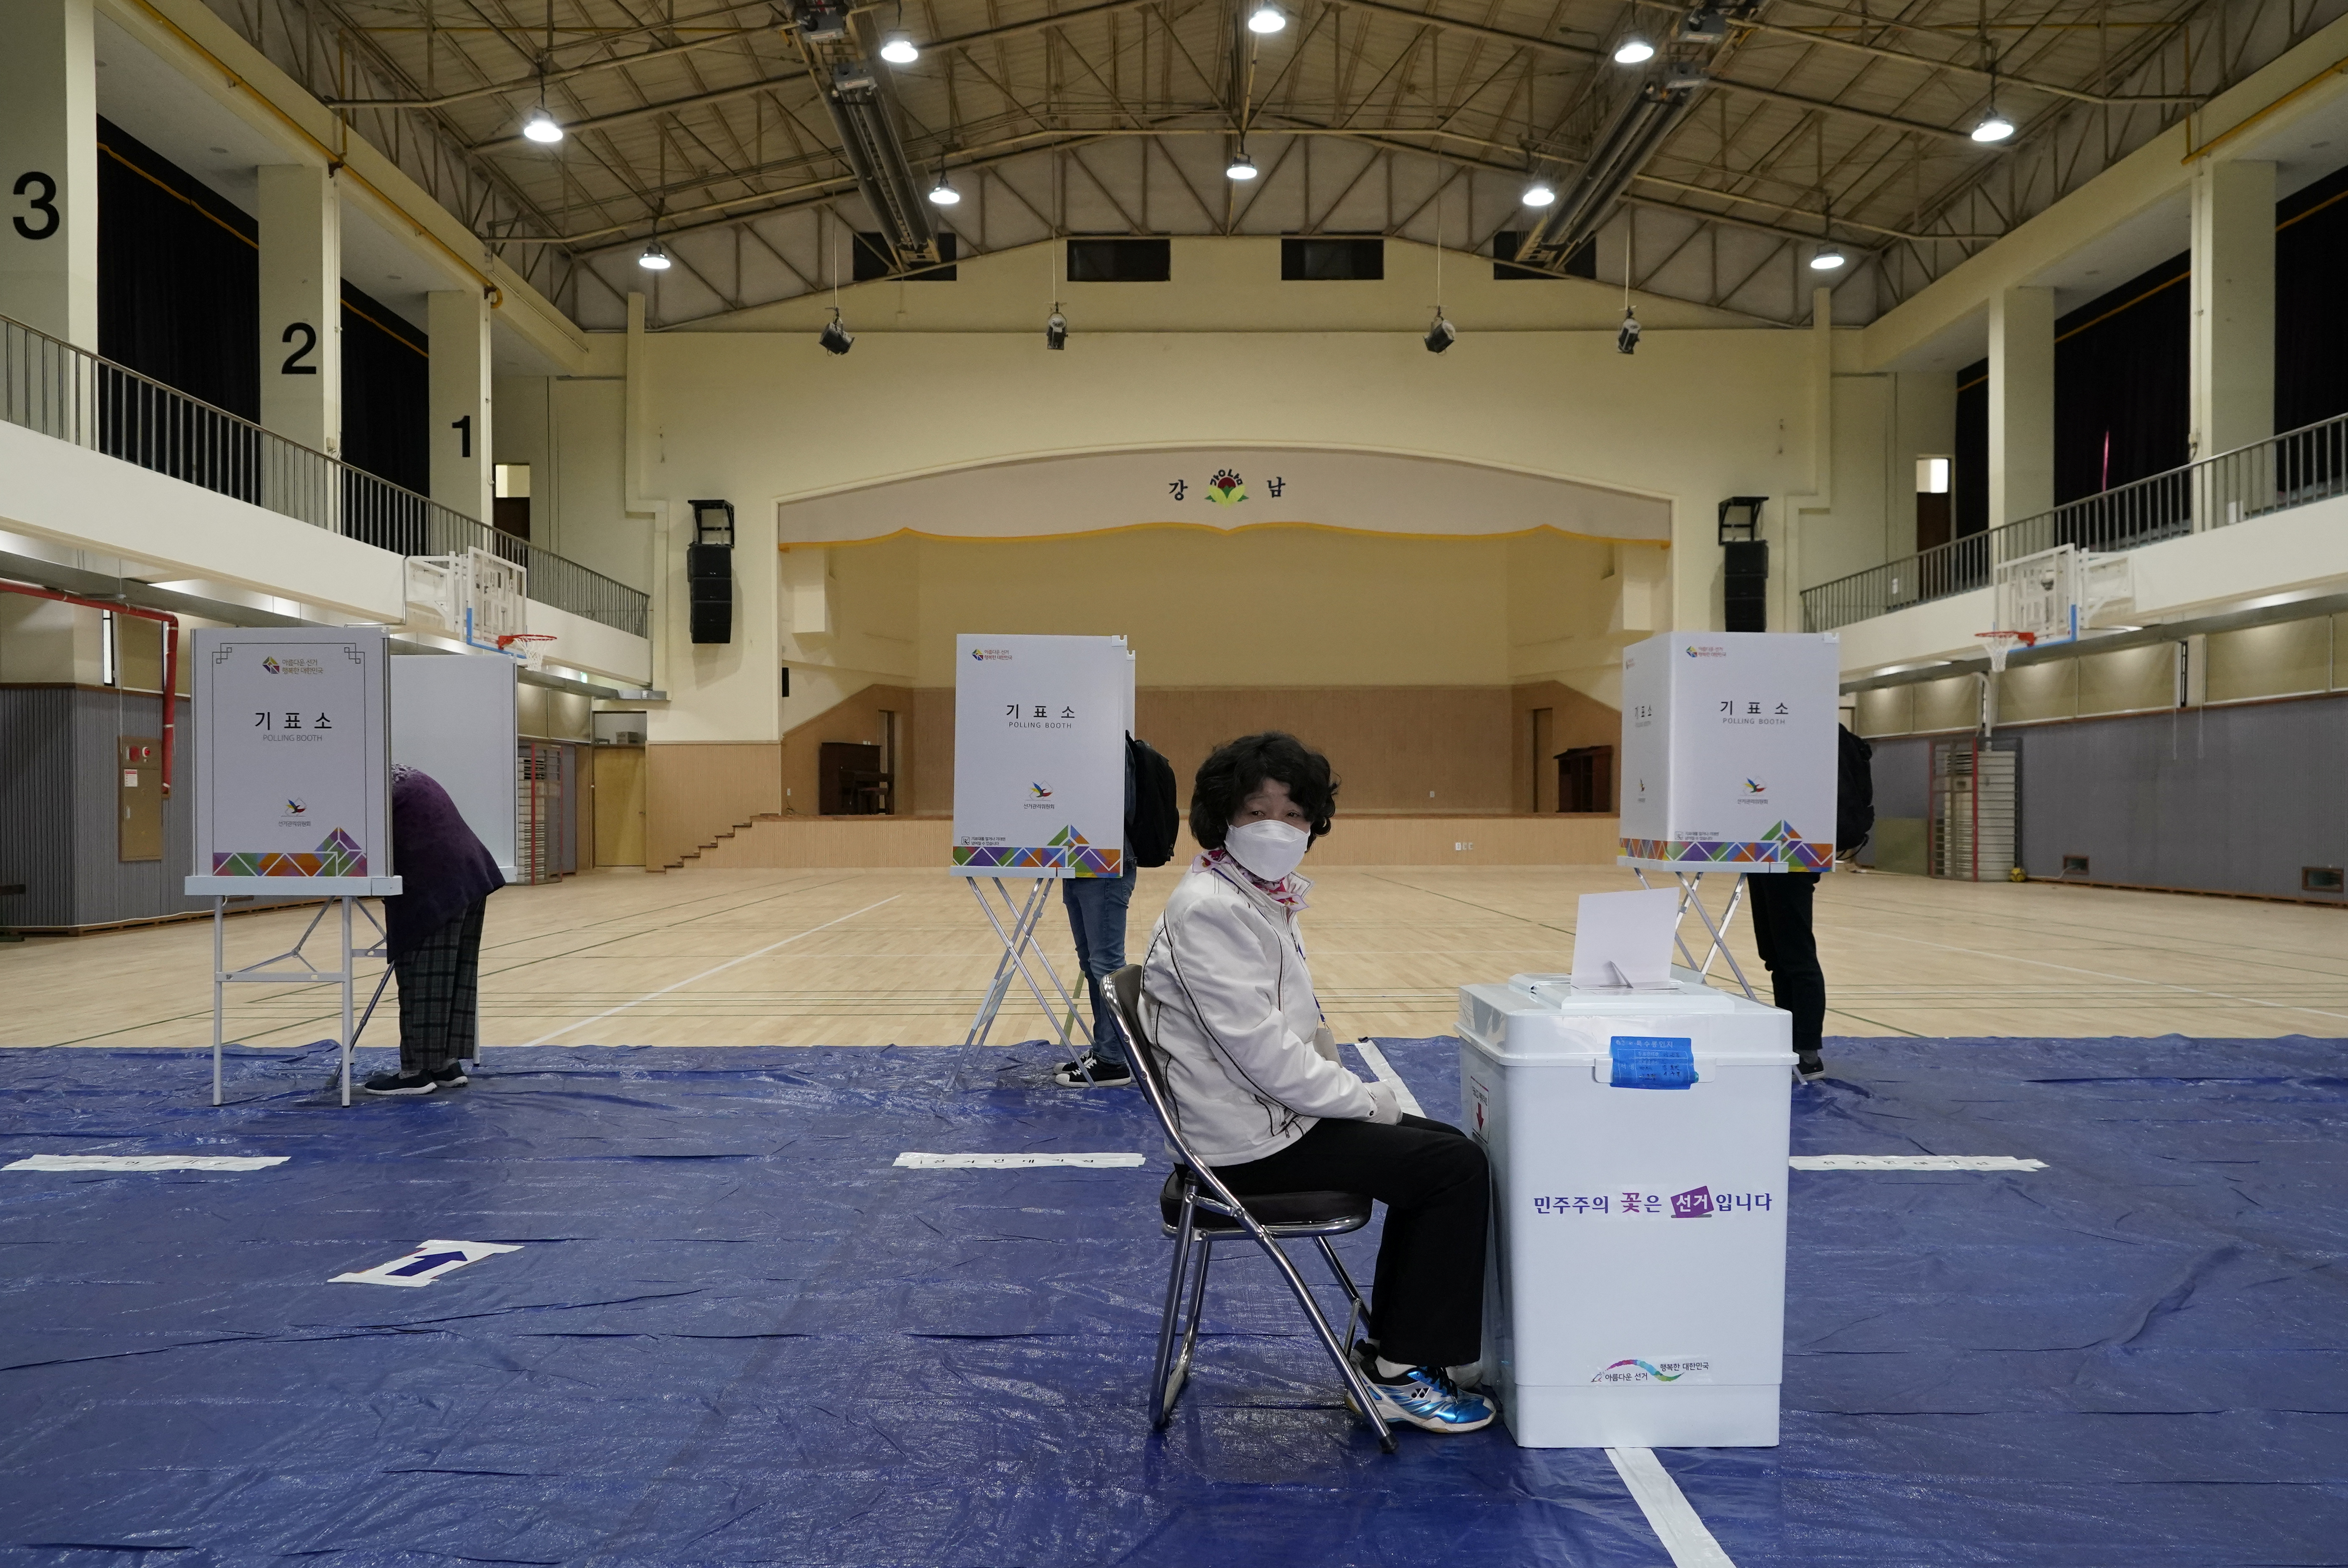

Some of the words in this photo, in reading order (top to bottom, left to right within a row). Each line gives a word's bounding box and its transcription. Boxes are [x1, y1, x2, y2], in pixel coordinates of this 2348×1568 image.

[13, 171, 60, 240] 3
[281, 322, 317, 374] 2
[452, 416, 470, 457] 1
[1169, 479, 1188, 501] 강
[1267, 477, 1286, 498] 남
[1534, 1196, 1609, 1214] 민주주의
[1620, 1192, 1662, 1213] 꽃은
[1605, 1373, 1632, 1382] 아름다운
[1660, 1363, 1680, 1372] 행복한
[1683, 1362, 1709, 1371] 대한민국
